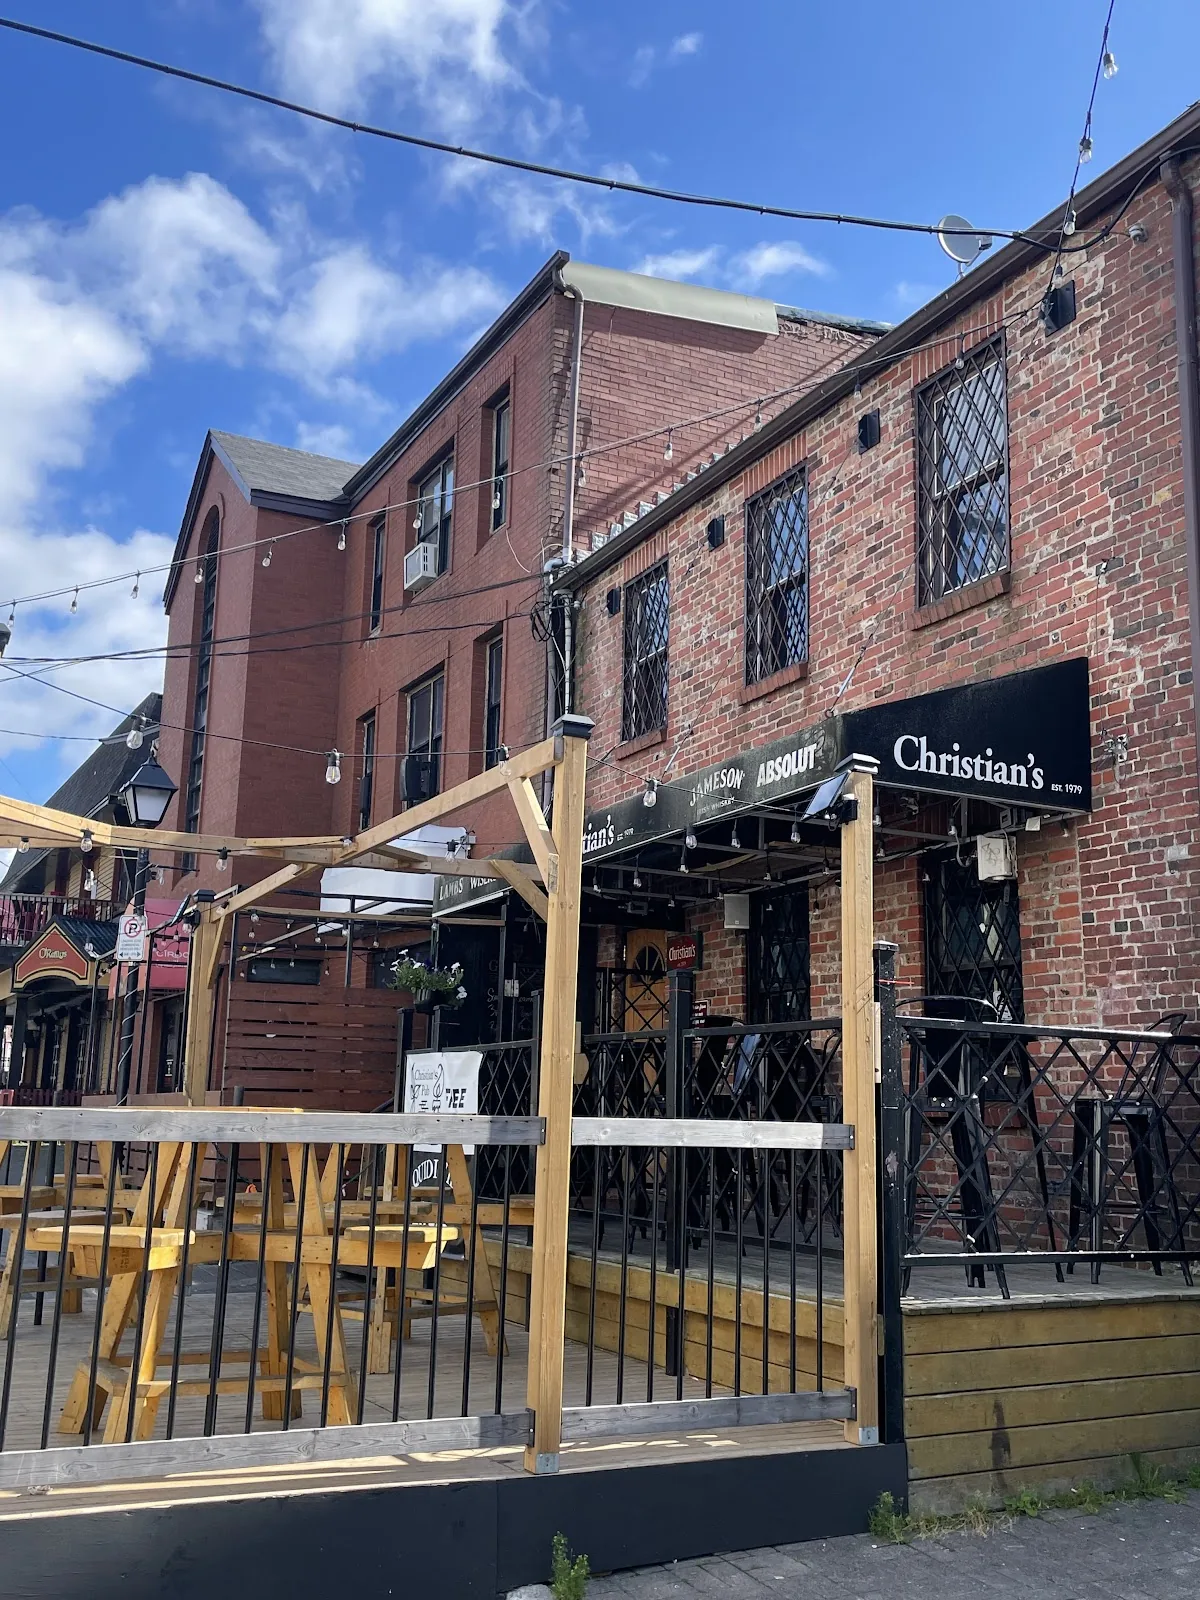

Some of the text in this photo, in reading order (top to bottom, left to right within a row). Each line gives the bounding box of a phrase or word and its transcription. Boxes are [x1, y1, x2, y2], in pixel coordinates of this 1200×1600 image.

[757, 743, 817, 788] ABSOLUT
[893, 734, 1044, 790] Christian's
[690, 767, 744, 807] JAMESON
[1051, 783, 1083, 794] EST. 1979
[668, 944, 696, 961] Christian's
